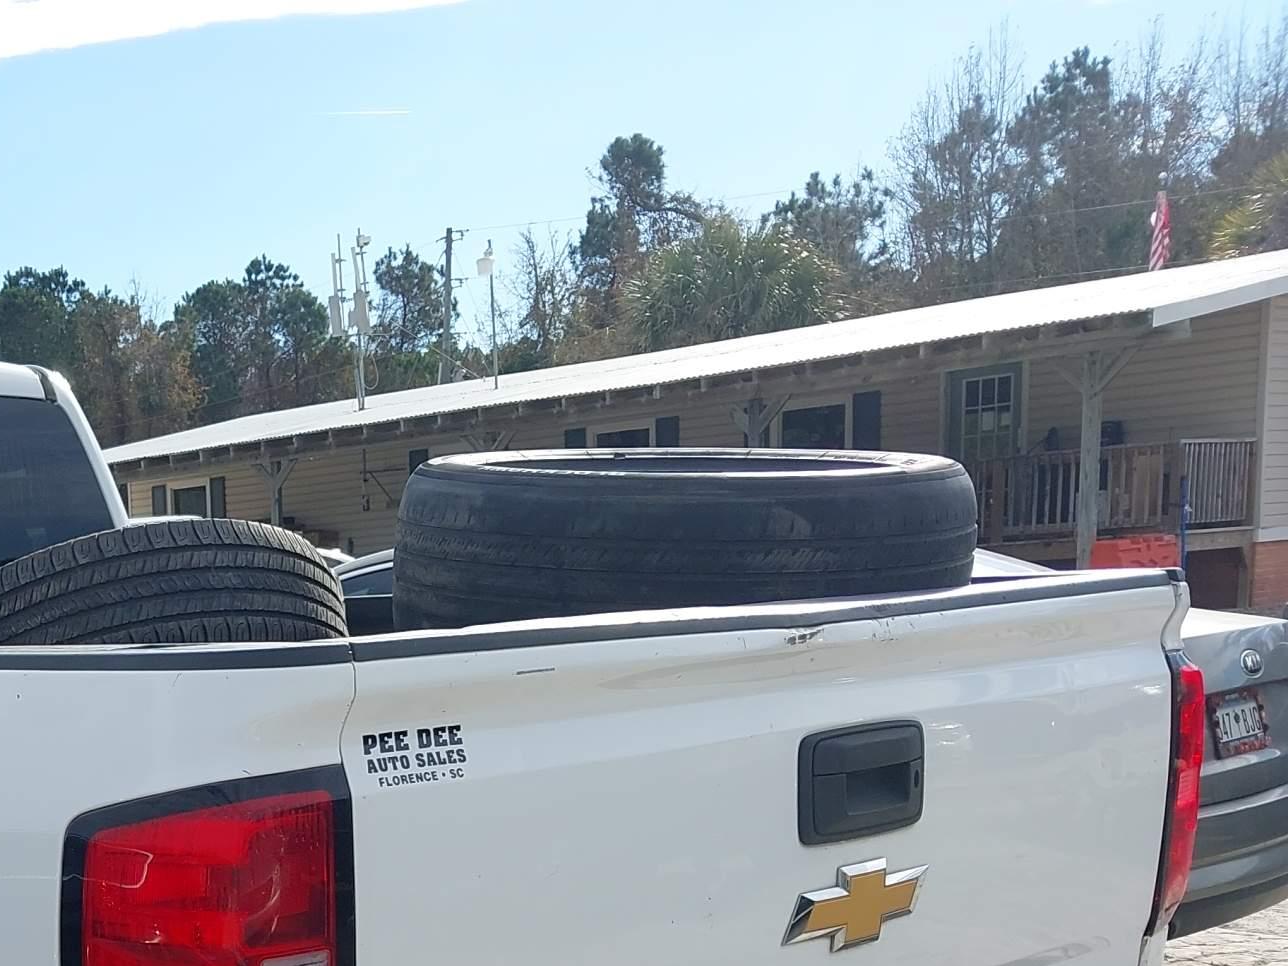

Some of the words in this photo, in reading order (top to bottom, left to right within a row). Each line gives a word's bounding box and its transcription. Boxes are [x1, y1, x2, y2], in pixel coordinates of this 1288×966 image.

[362, 729, 410, 755] PEE
[416, 724, 463, 749] DEE
[367, 755, 410, 774] AUTO
[415, 748, 467, 768] SALES
[378, 771, 439, 787] FLORENCE
[449, 768, 464, 779] SC
